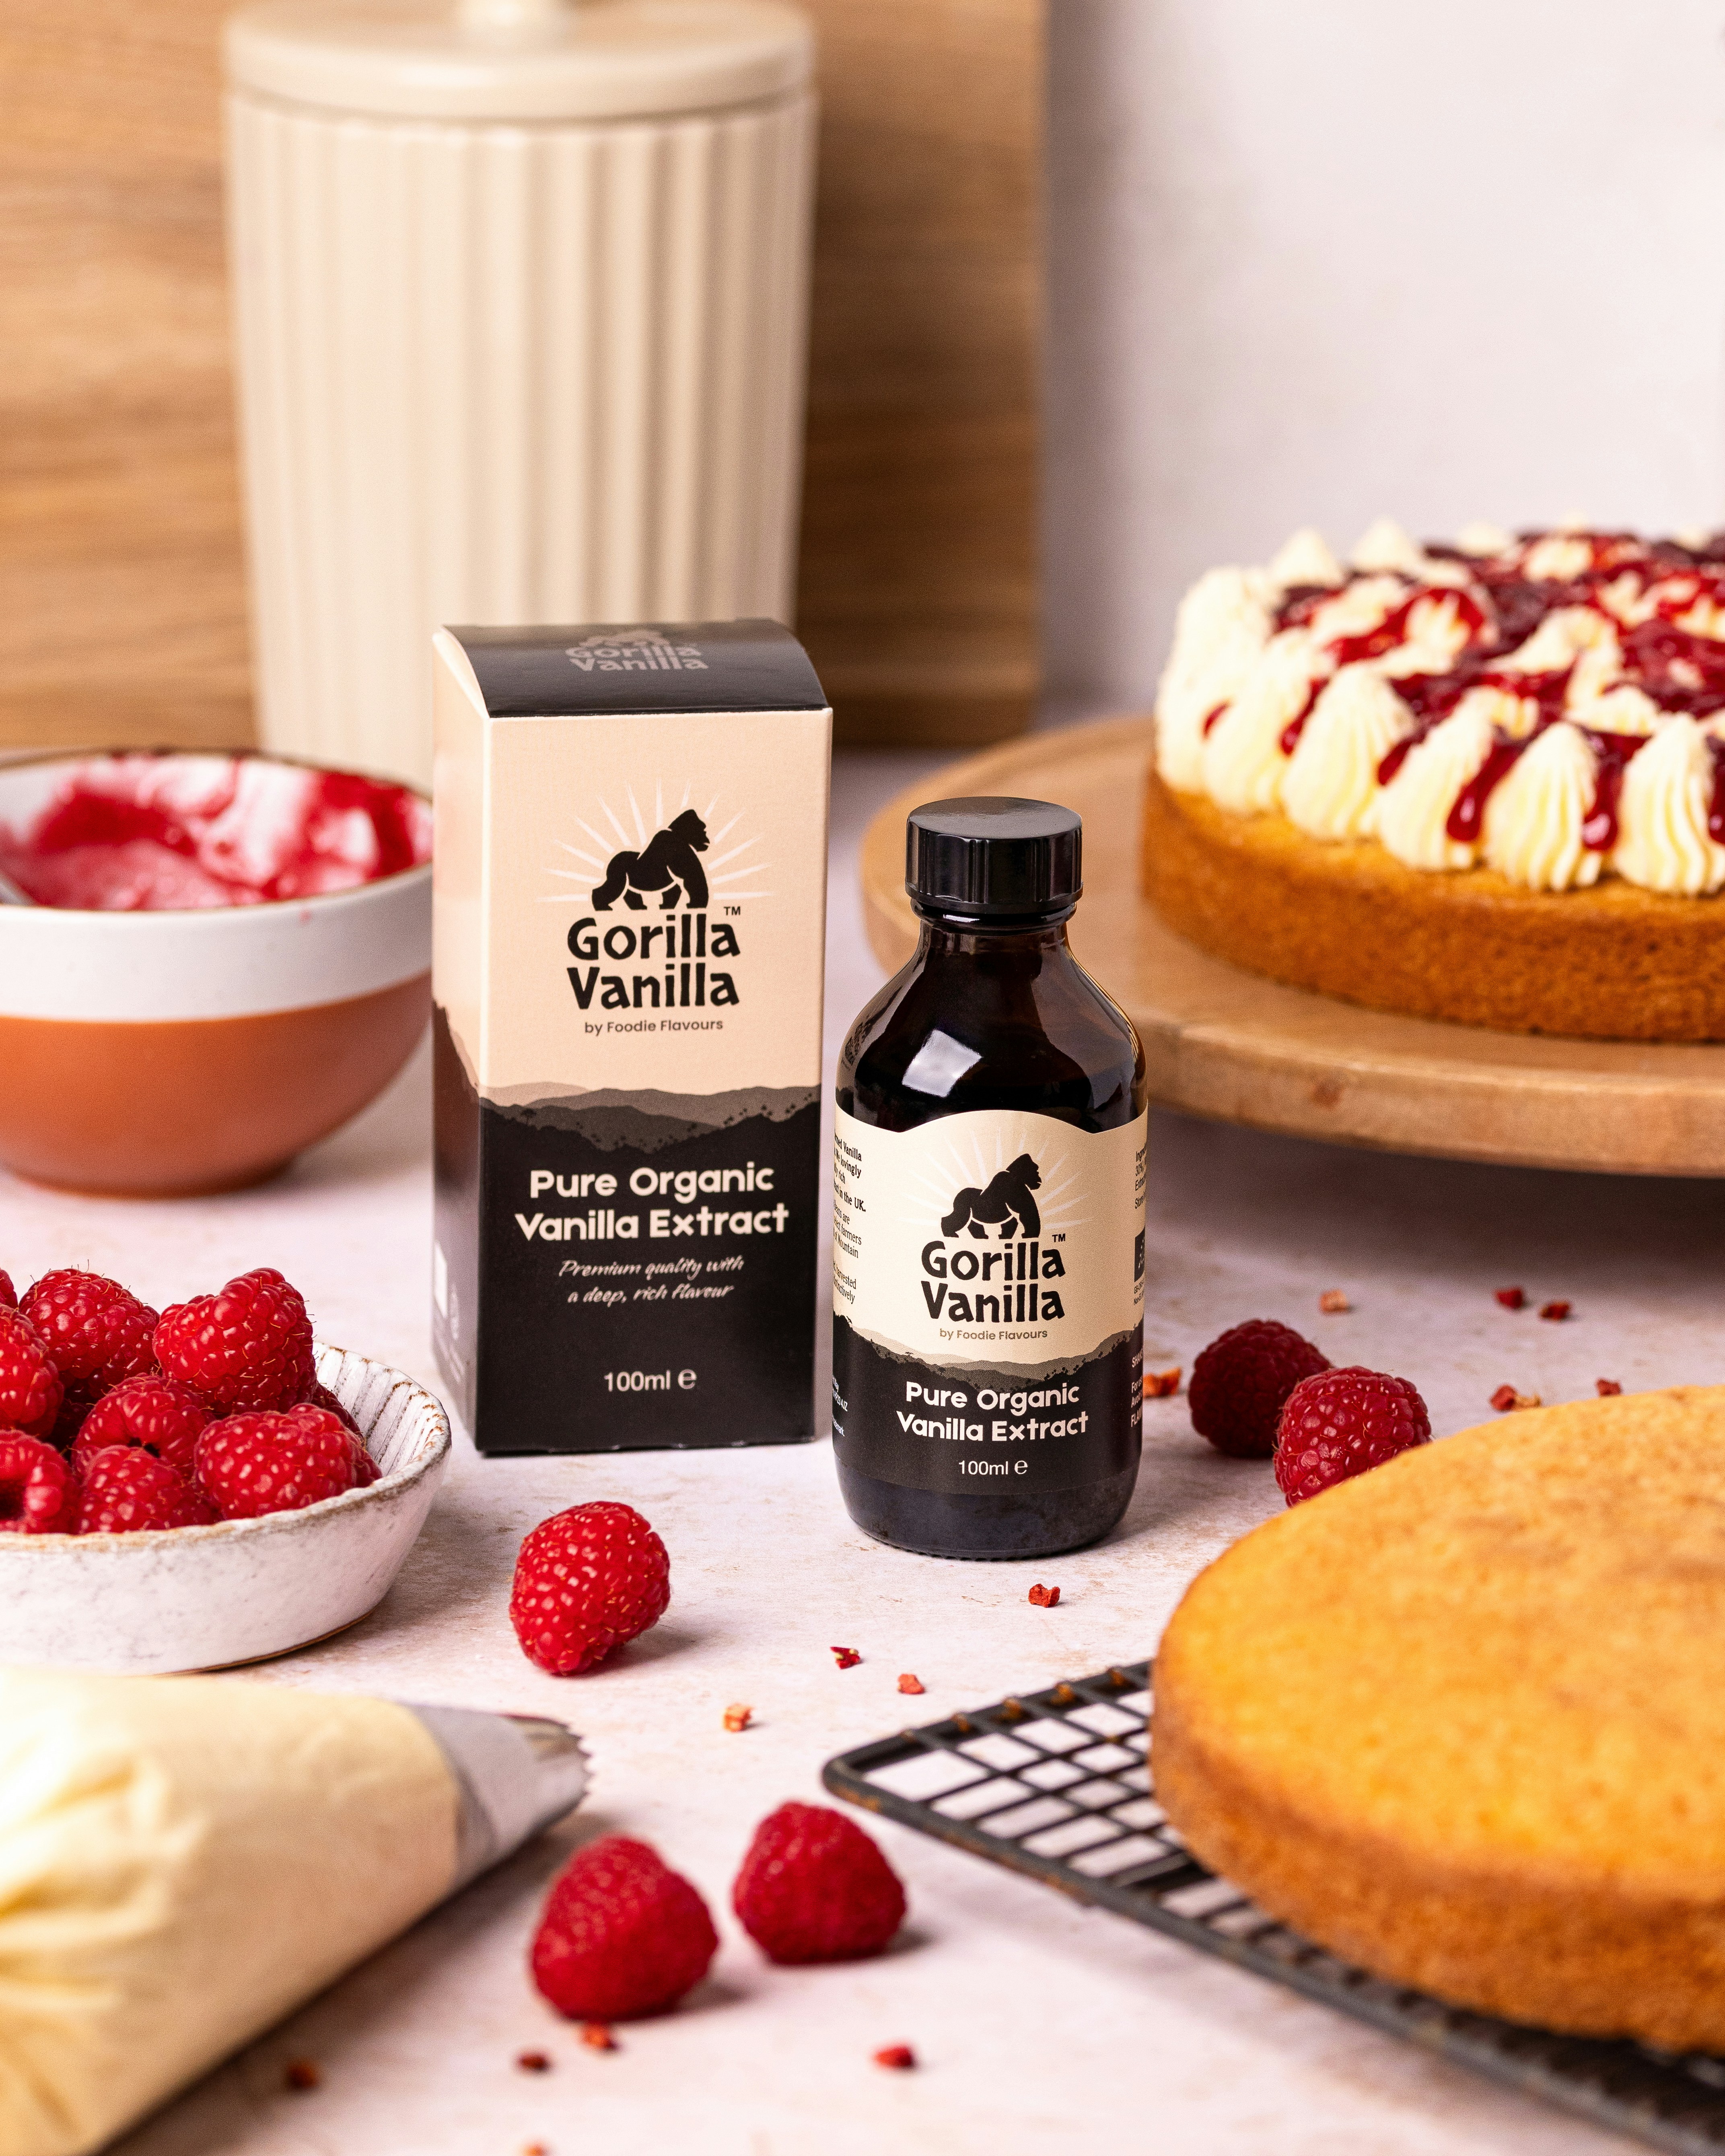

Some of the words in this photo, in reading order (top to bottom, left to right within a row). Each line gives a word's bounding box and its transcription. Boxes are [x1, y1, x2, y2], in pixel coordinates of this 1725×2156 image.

[565, 644, 702, 657] Gorilla
[569, 656, 709, 671] Vanilla
[567, 913, 741, 961] Gorilla
[566, 962, 740, 1010] Vanilla
[585, 1022, 603, 1037] by
[607, 1020, 656, 1033] Foodie
[660, 1019, 723, 1032] Flavours
[843, 1141, 862, 1161] Vanilla
[841, 1154, 861, 1179] lovingly
[530, 1170, 618, 1198] Pure
[629, 1161, 774, 1204] Organic
[844, 1191, 852, 1205] the
[854, 1197, 866, 1212] UK.
[514, 1209, 639, 1241] Vanilla
[649, 1203, 789, 1238] Extract
[842, 1224, 862, 1245] farmers
[559, 1260, 642, 1277] Premium
[645, 1257, 702, 1281] quality
[706, 1255, 745, 1272] with
[921, 1240, 1066, 1281] Gorilla
[568, 1291, 578, 1303] a
[583, 1286, 627, 1308] deep,
[633, 1284, 668, 1301] rich
[671, 1283, 735, 1299] flavour
[920, 1281, 1065, 1323] Vanilla
[940, 1328, 954, 1341] by
[957, 1330, 996, 1340] Foodie
[999, 1330, 1048, 1340] Flavours
[604, 1369, 671, 1392] 100ml
[906, 1381, 967, 1408] Pure
[977, 1382, 1080, 1417] Organic
[896, 1411, 983, 1441] Vanilla
[992, 1411, 1088, 1441] Extract
[958, 1460, 1008, 1475] 100ml
